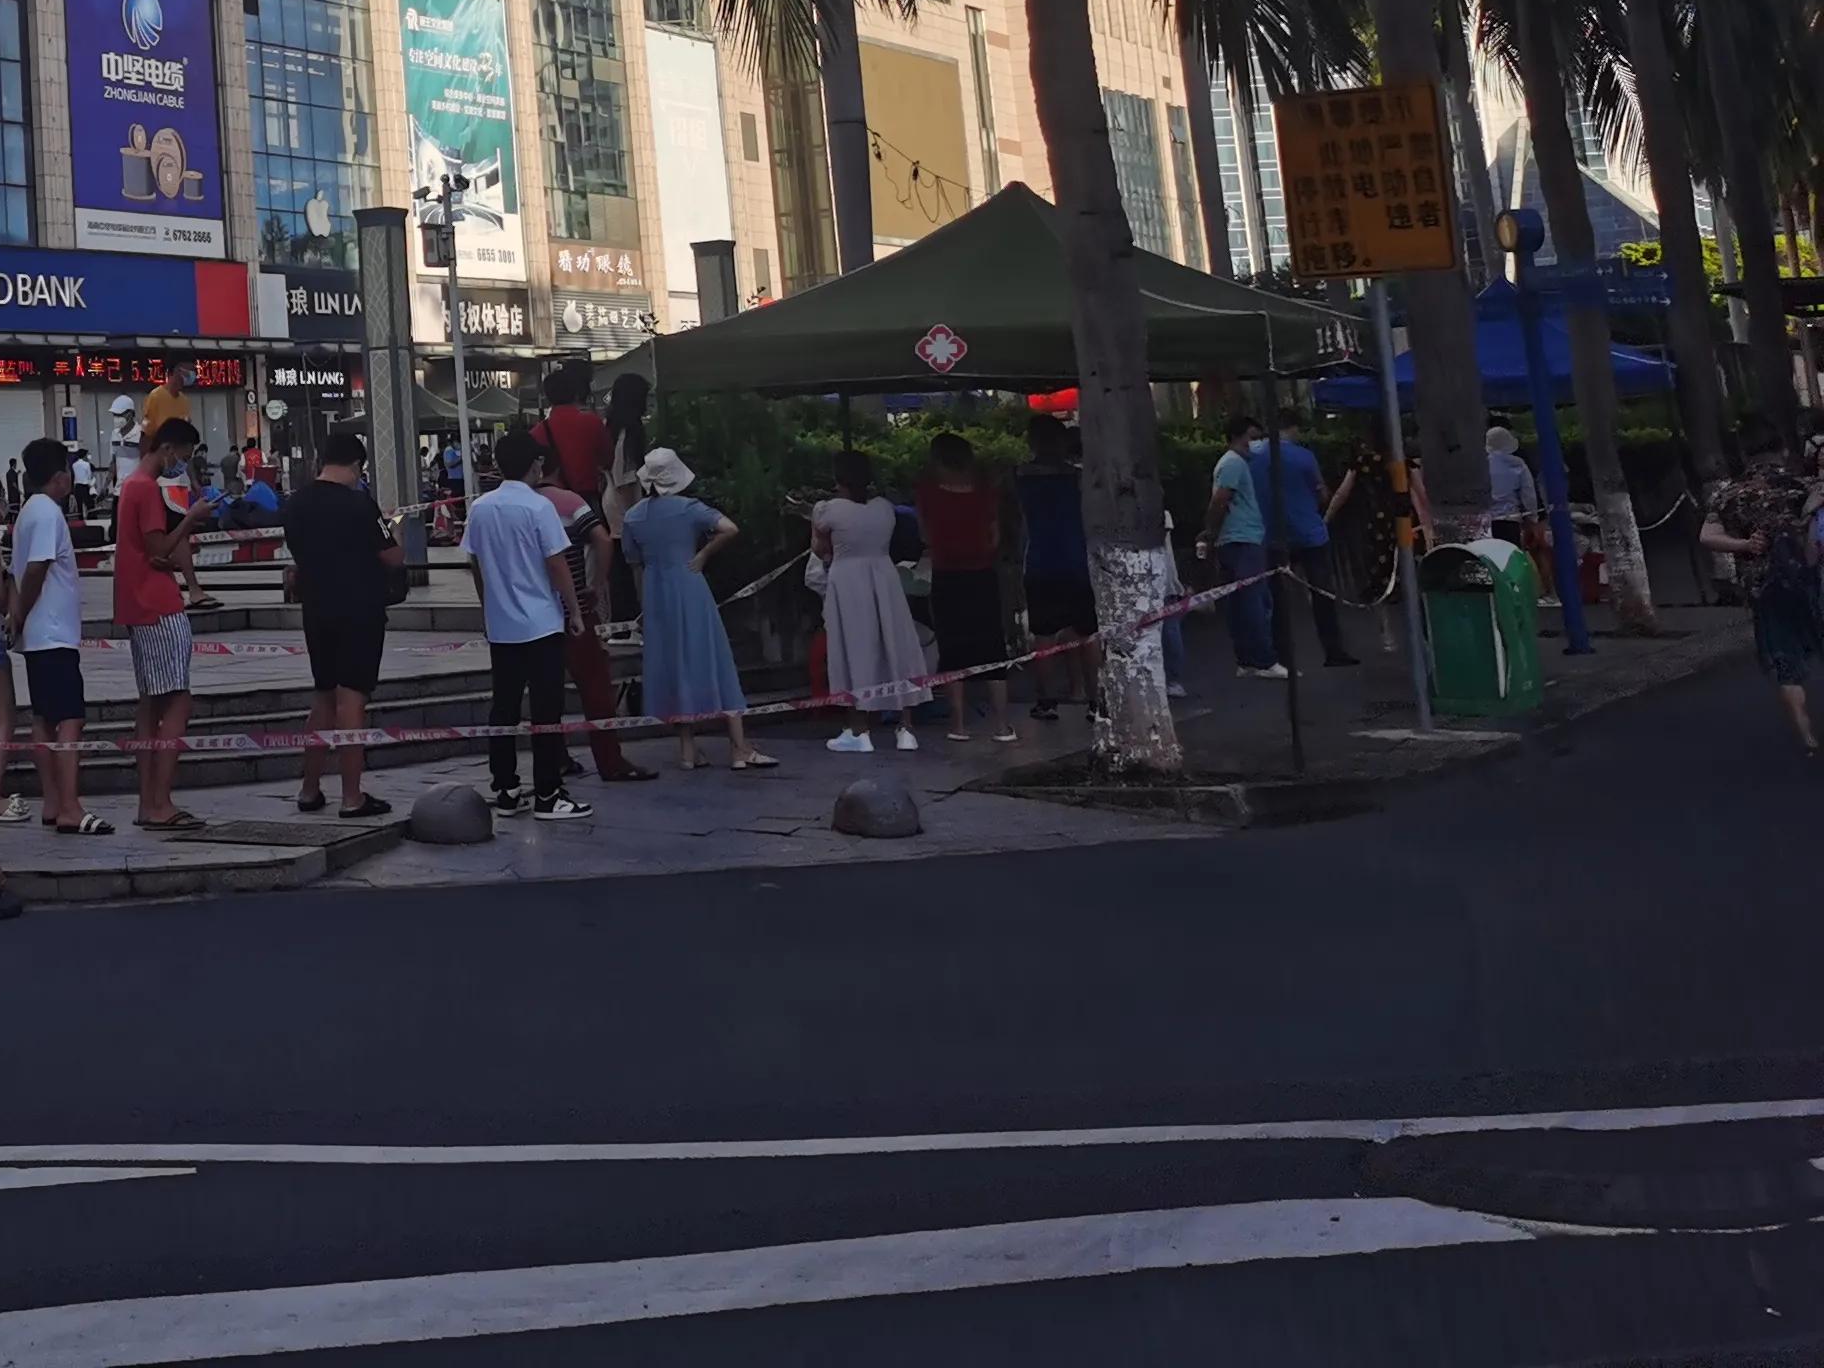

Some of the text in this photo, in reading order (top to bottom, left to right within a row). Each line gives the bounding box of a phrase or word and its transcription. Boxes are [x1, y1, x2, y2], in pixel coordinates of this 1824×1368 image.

[101, 52, 185, 92] 中坚电缆
[103, 85, 185, 109] ZHONGJIAN CABLE
[16, 272, 87, 309] BANK
[286, 286, 309, 316] 琅
[463, 370, 512, 390] HUAWEI
